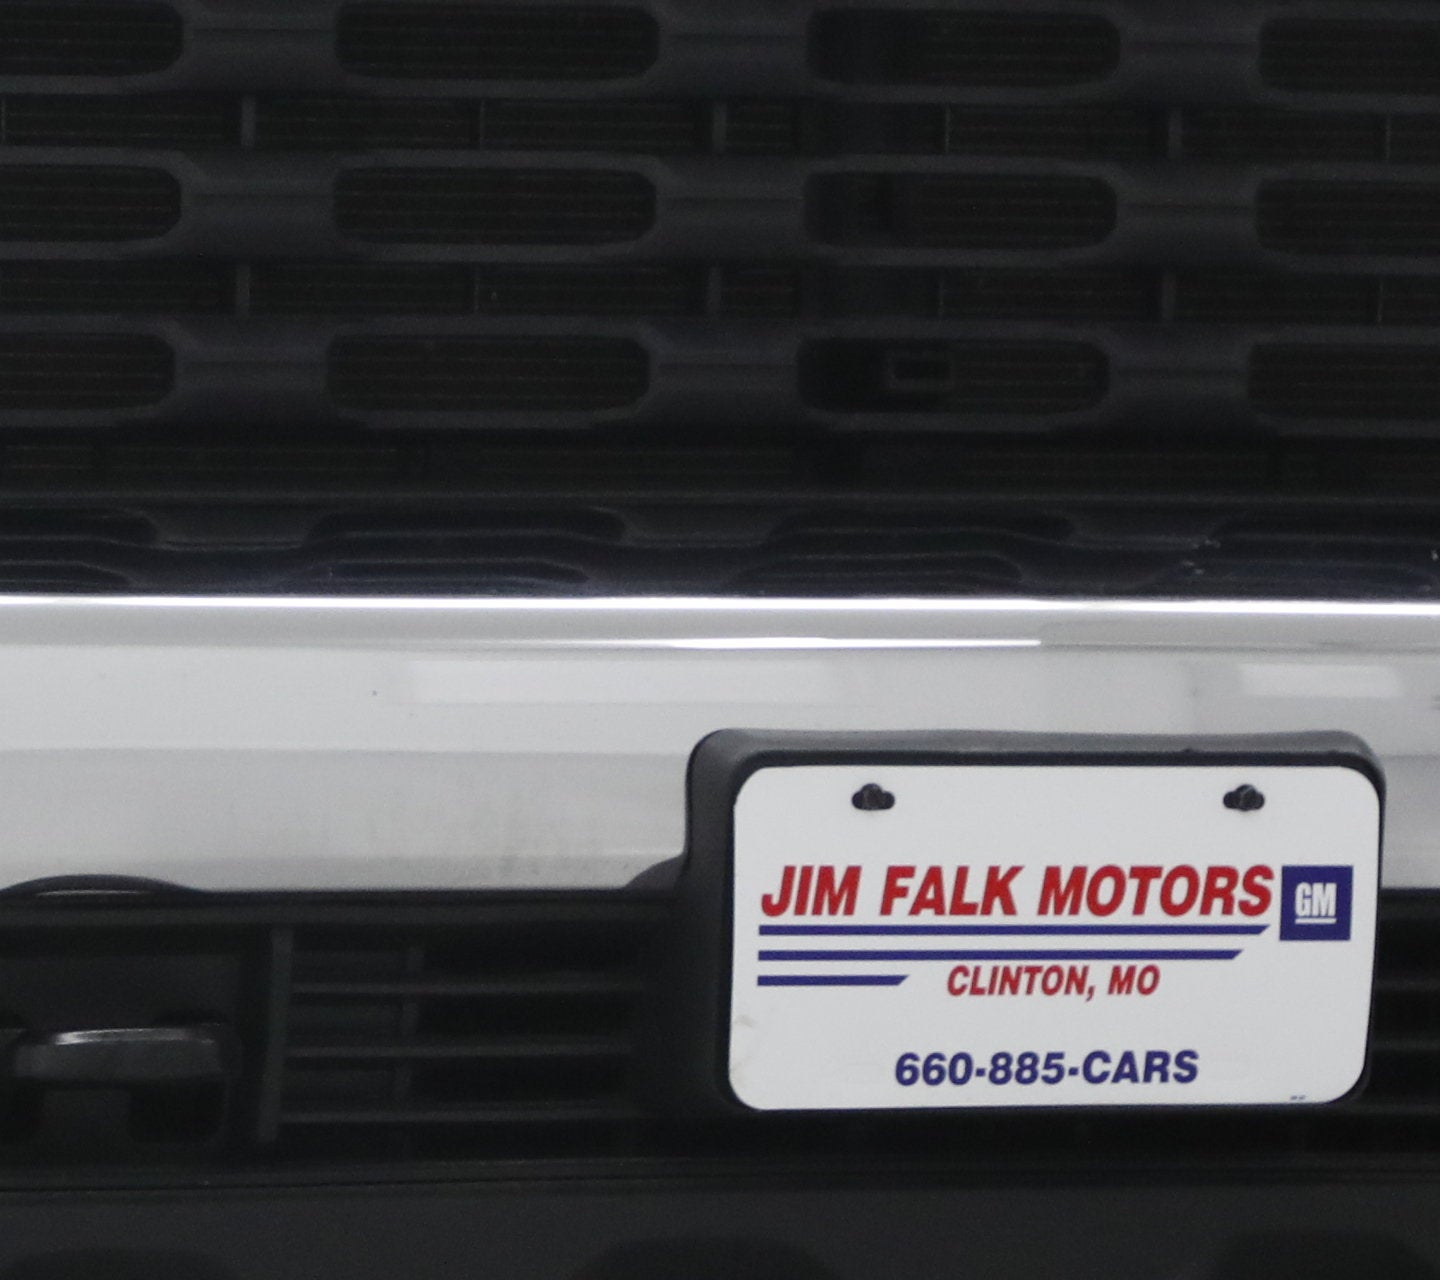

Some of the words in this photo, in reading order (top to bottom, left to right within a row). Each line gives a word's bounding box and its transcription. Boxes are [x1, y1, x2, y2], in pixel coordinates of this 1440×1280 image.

[761, 865, 862, 917] JIM
[879, 865, 1024, 917] FALK
[1036, 864, 1275, 917] MOTORS
[1294, 881, 1338, 925] GM
[946, 965, 1096, 1003] CLINTON,
[1106, 965, 1161, 997] MO
[894, 1049, 1200, 1087] 660-885-CARS
